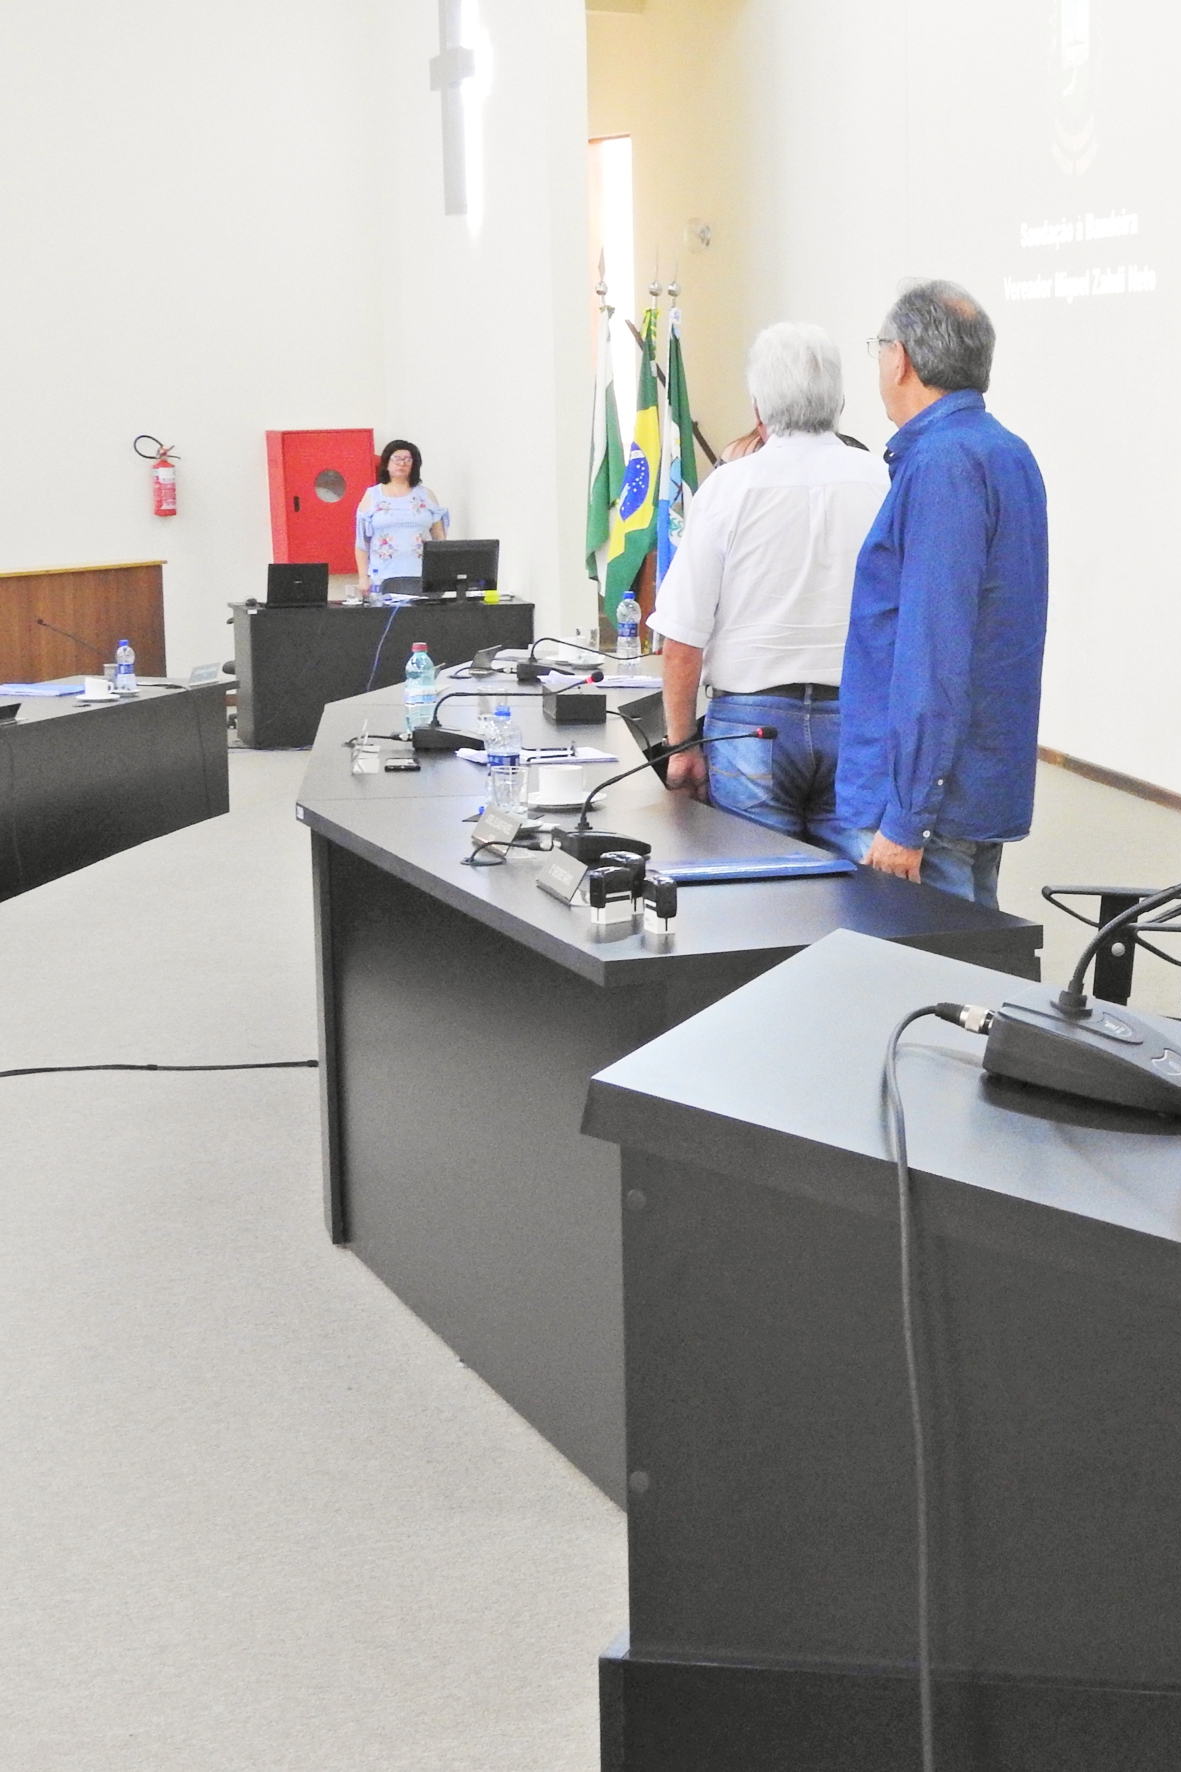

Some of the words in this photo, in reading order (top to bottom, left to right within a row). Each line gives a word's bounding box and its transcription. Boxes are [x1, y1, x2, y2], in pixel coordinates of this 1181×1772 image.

[1020, 216, 1074, 250] Saudação
[1085, 208, 1139, 241] Bandeira
[1003, 273, 1053, 301] Vereador
[1054, 269, 1090, 304] Miguel
[1127, 264, 1157, 293] Neto
